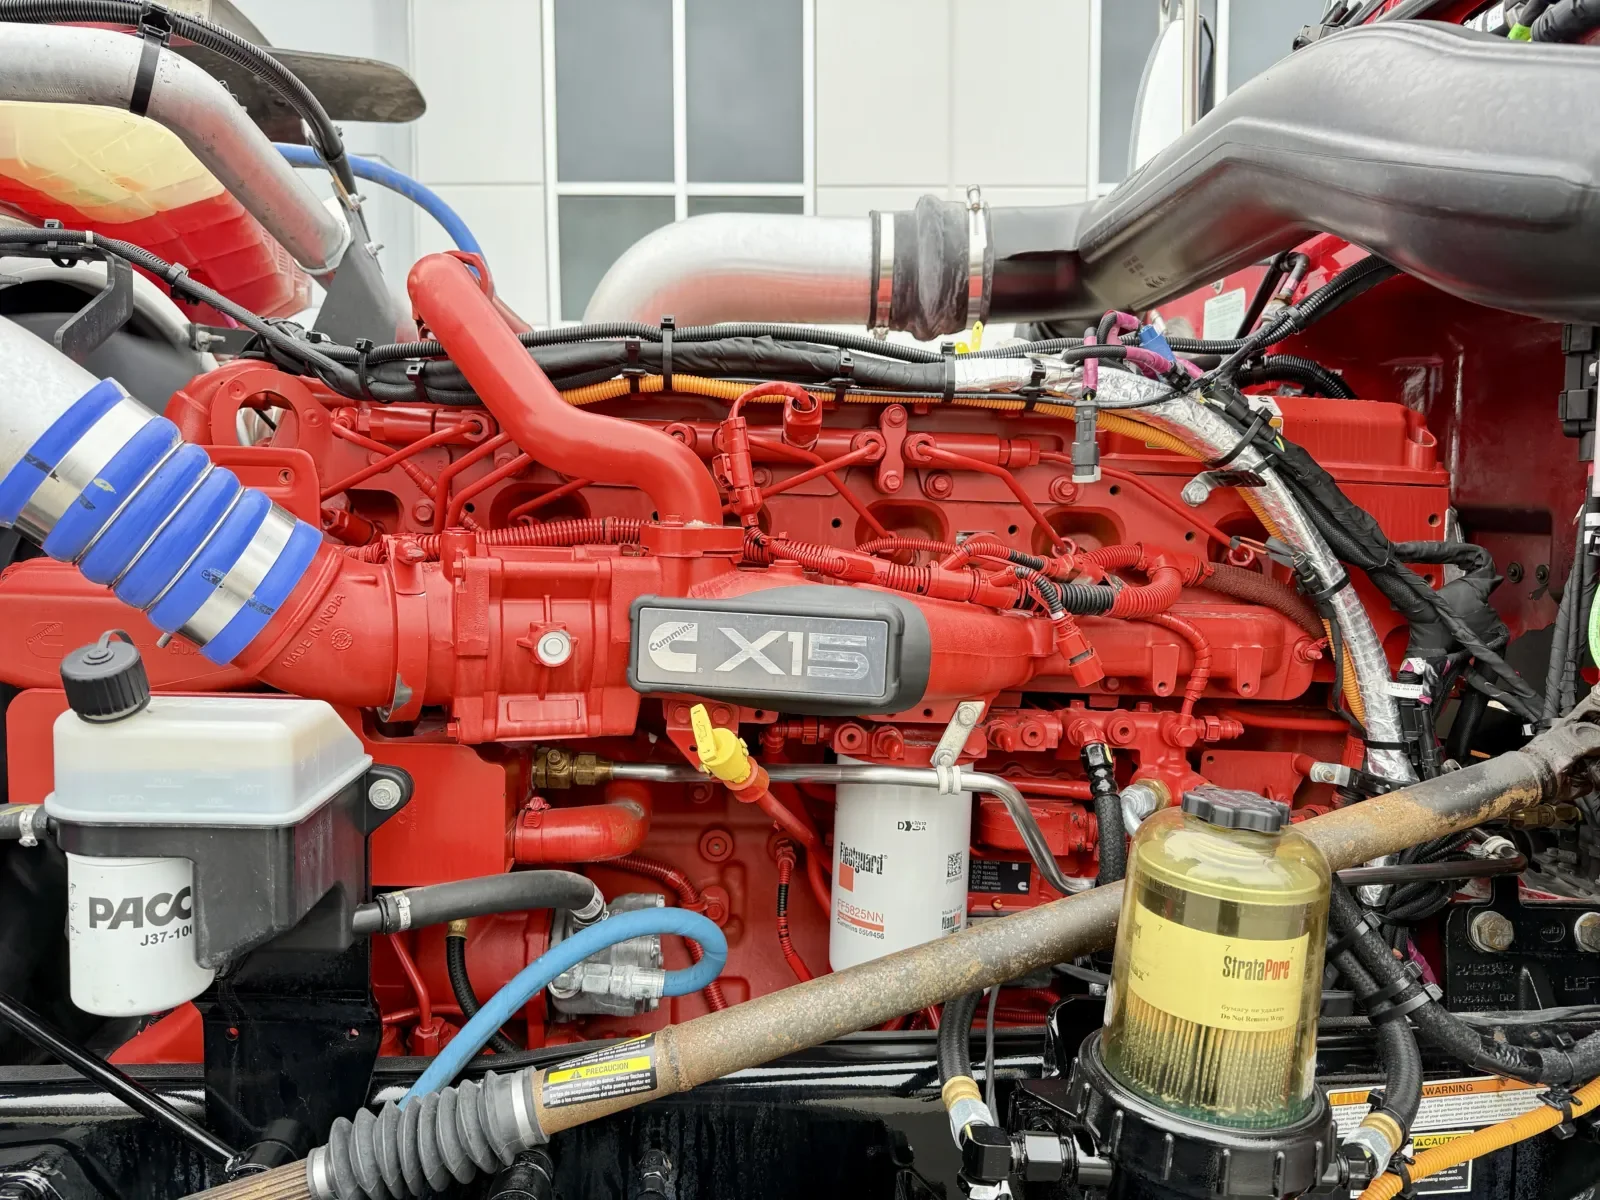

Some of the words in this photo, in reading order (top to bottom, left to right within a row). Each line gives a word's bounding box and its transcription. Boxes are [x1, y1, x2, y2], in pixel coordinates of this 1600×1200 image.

[282, 639, 313, 668] MADE
[308, 624, 323, 638] IN
[319, 593, 346, 626] INDIA
[649, 622, 695, 652] Cummins
[714, 627, 870, 680] X15
[840, 841, 884, 875] Fleetguard
[89, 886, 192, 930] PACC
[837, 898, 884, 923] FF5825NN
[140, 926, 193, 946] J37-10
[1222, 955, 1290, 981] StrataPore
[1564, 976, 1600, 991] LEF
[585, 1062, 629, 1076] PRECAUCION
[1425, 1083, 1473, 1096] WARNING
[1424, 1136, 1464, 1147] CAUT
